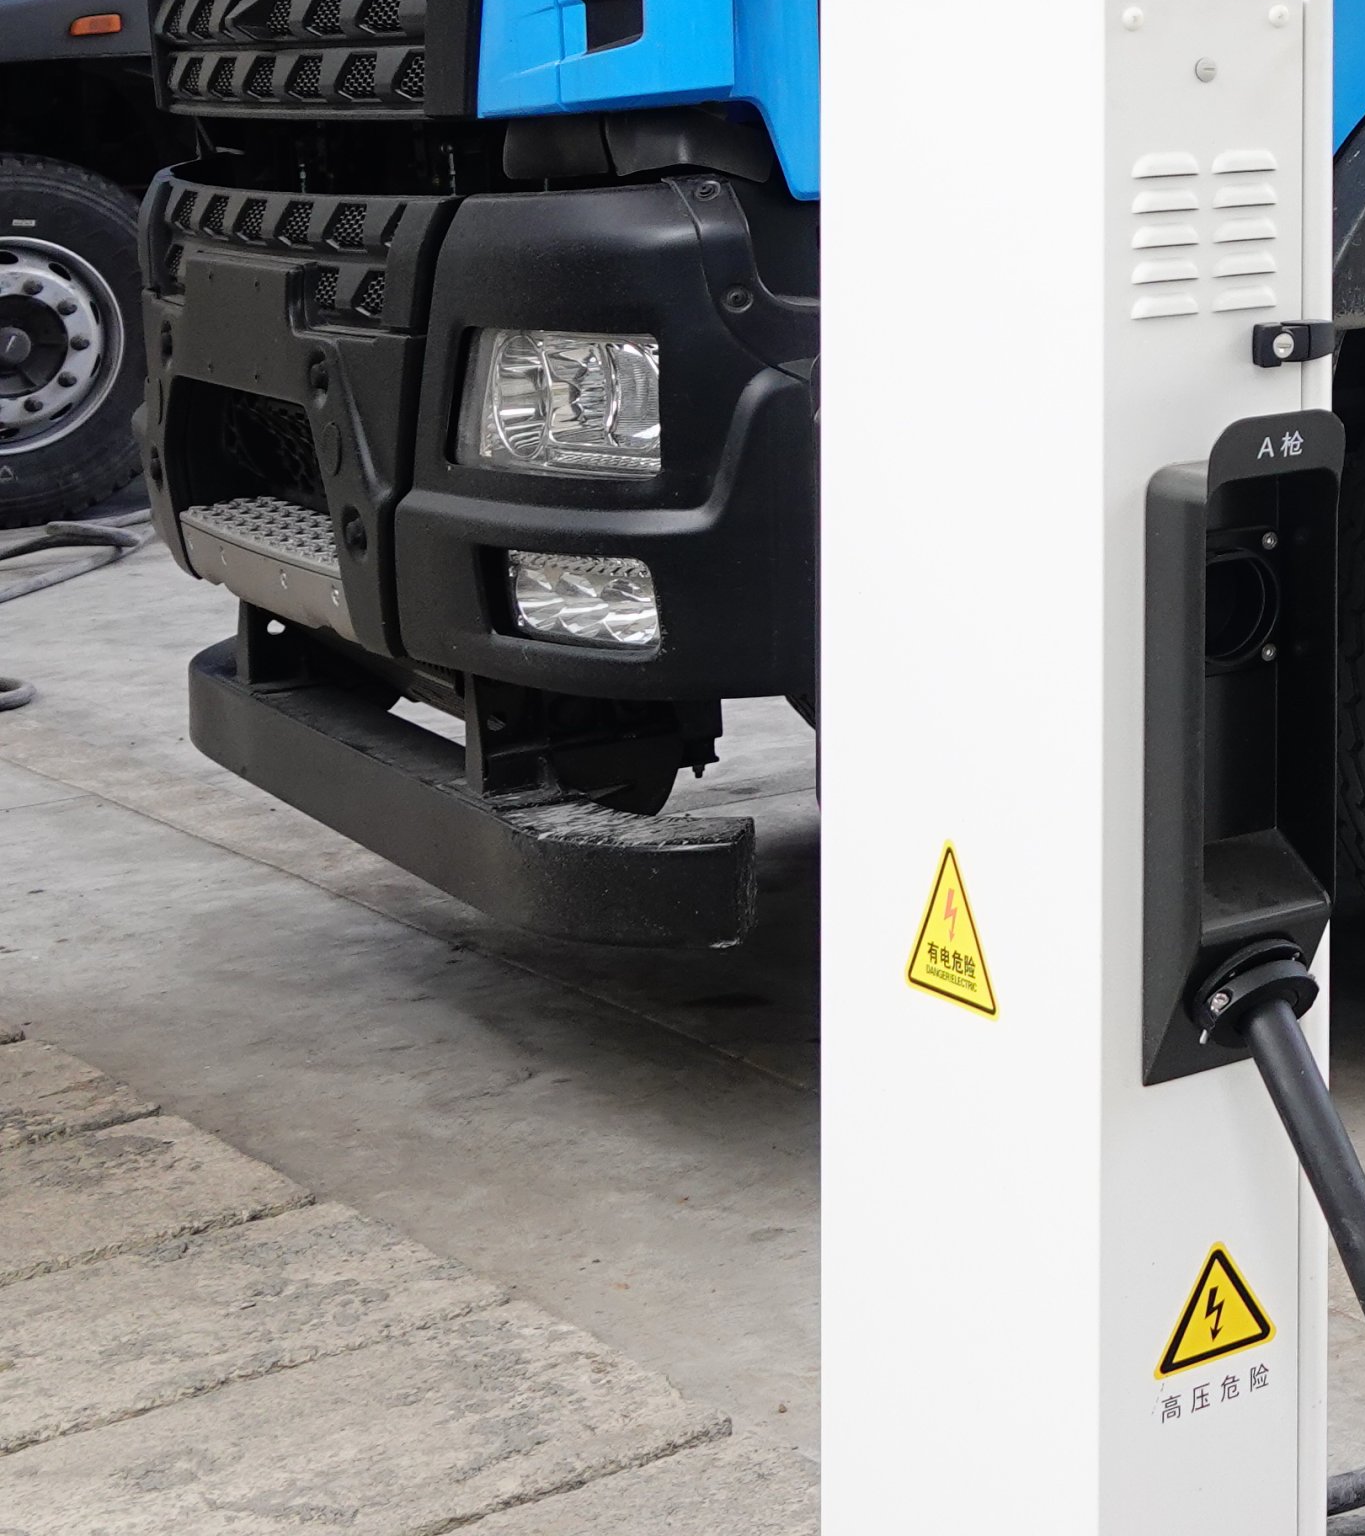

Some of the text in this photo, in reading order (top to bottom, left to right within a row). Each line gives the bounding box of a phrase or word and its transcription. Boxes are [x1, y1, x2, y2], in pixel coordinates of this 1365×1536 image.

[1280, 430, 1304, 457] 枪
[927, 940, 976, 980] 有电危险
[1161, 1363, 1269, 1424] 高压危险
